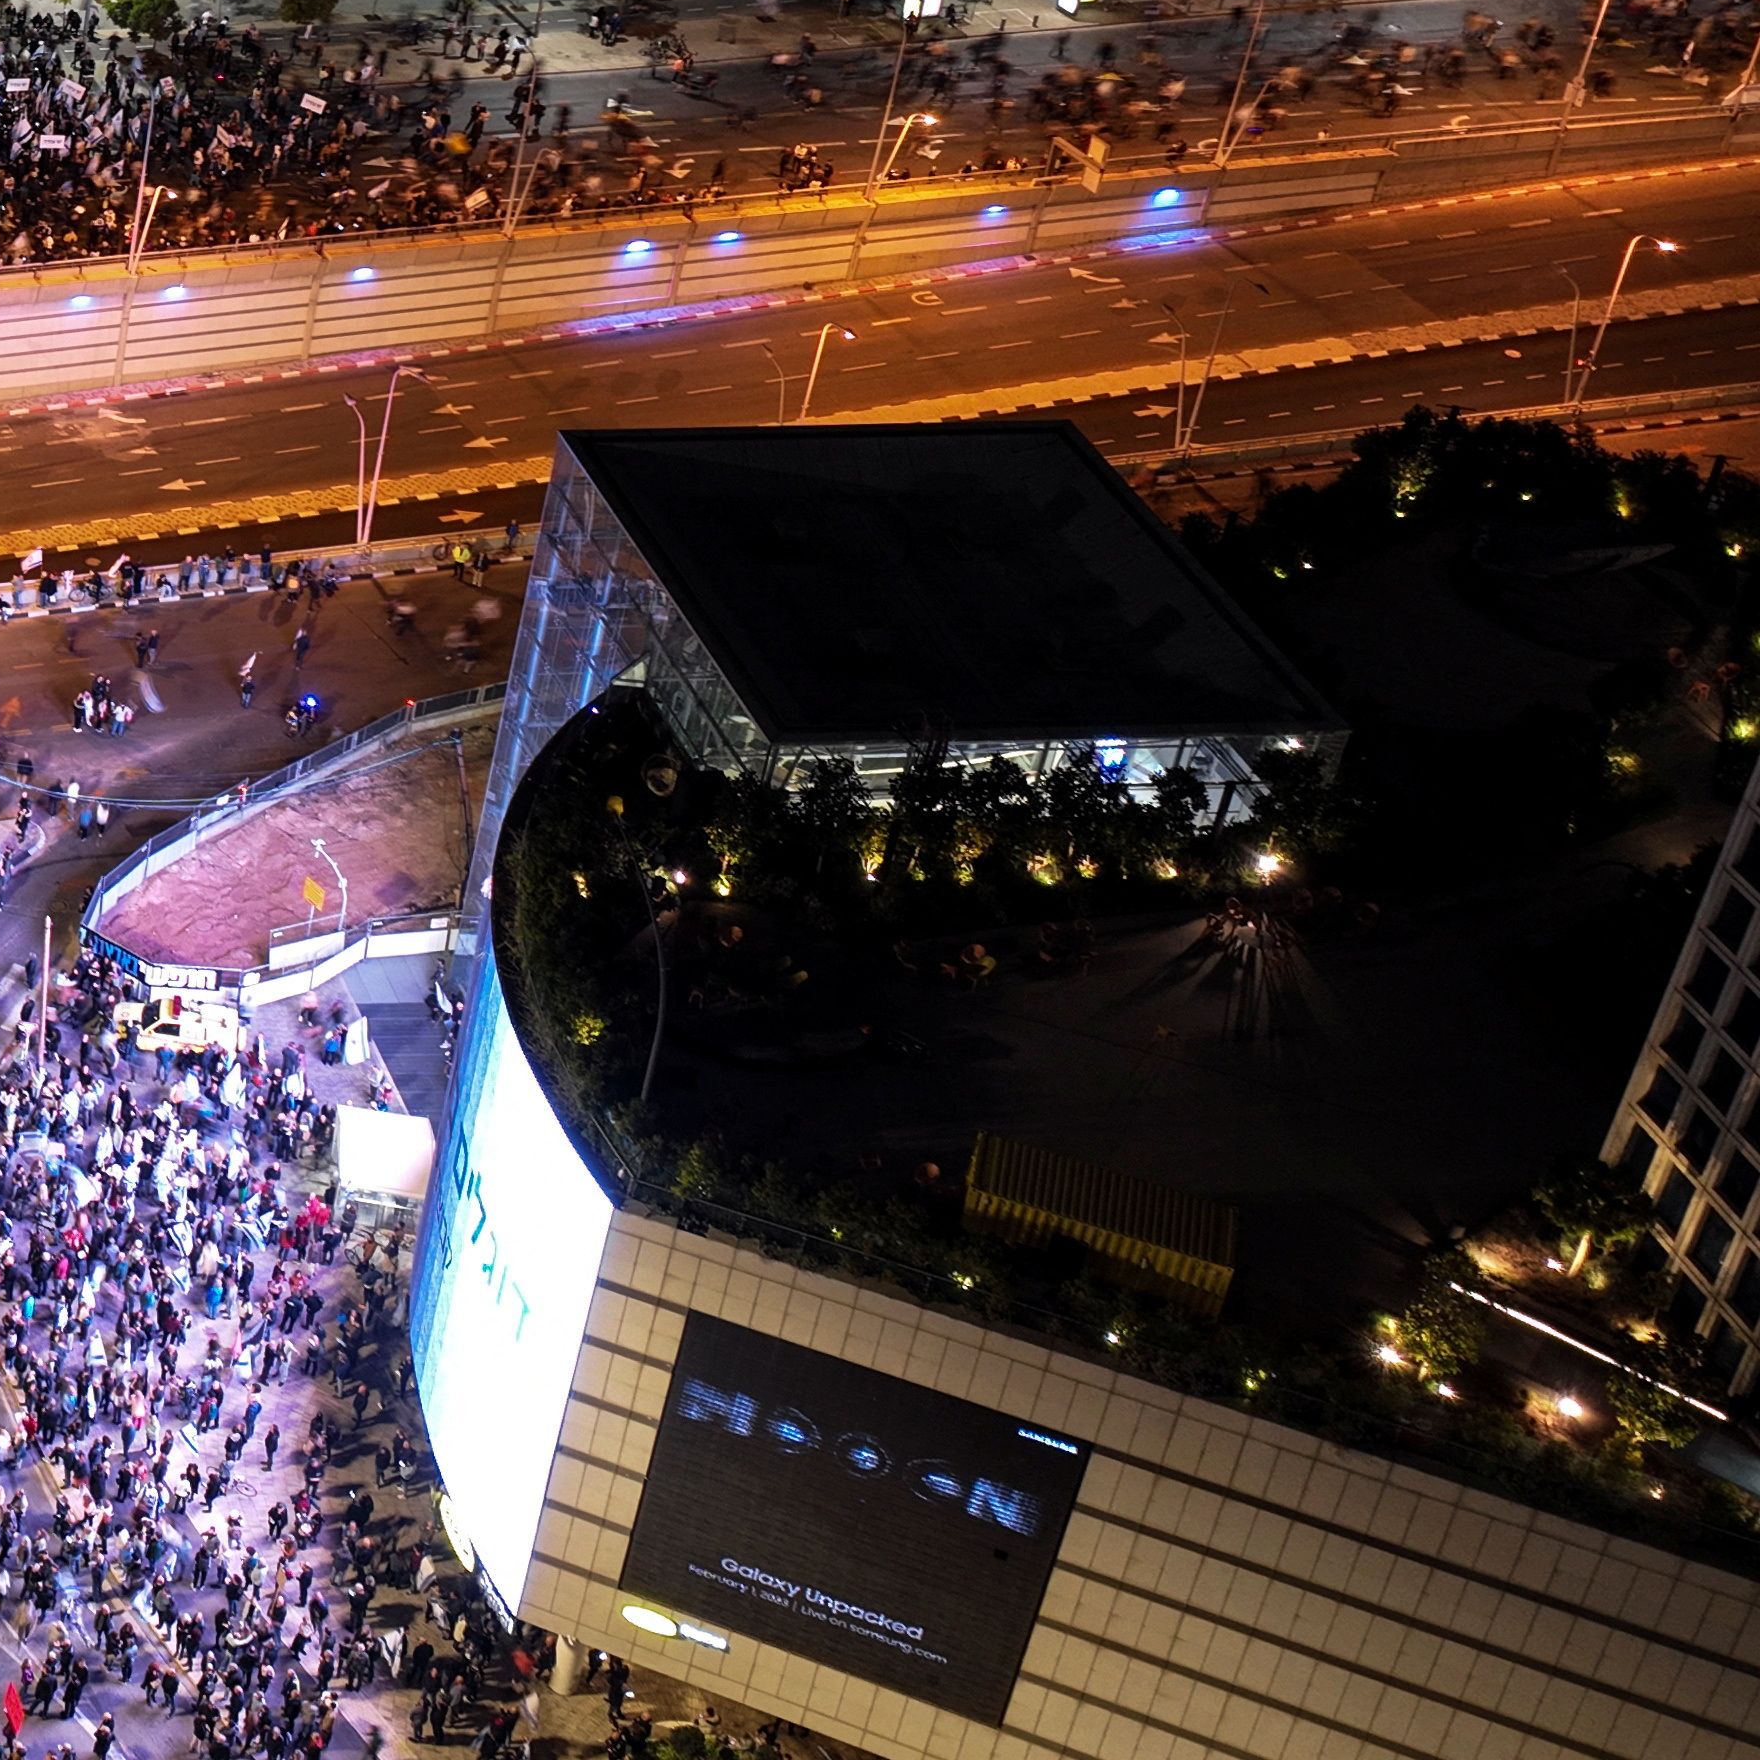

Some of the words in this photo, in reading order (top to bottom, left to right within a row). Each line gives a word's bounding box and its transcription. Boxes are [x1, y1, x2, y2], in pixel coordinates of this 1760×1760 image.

[138, 959, 218, 991] חופשי
[688, 1563, 748, 1594] February
[800, 1604, 827, 1622] Live
[829, 1616, 848, 1630] on
[850, 1623, 948, 1665] samsung.com
[721, 1557, 800, 1598] Galaxy
[805, 1586, 925, 1640] Unpacked
